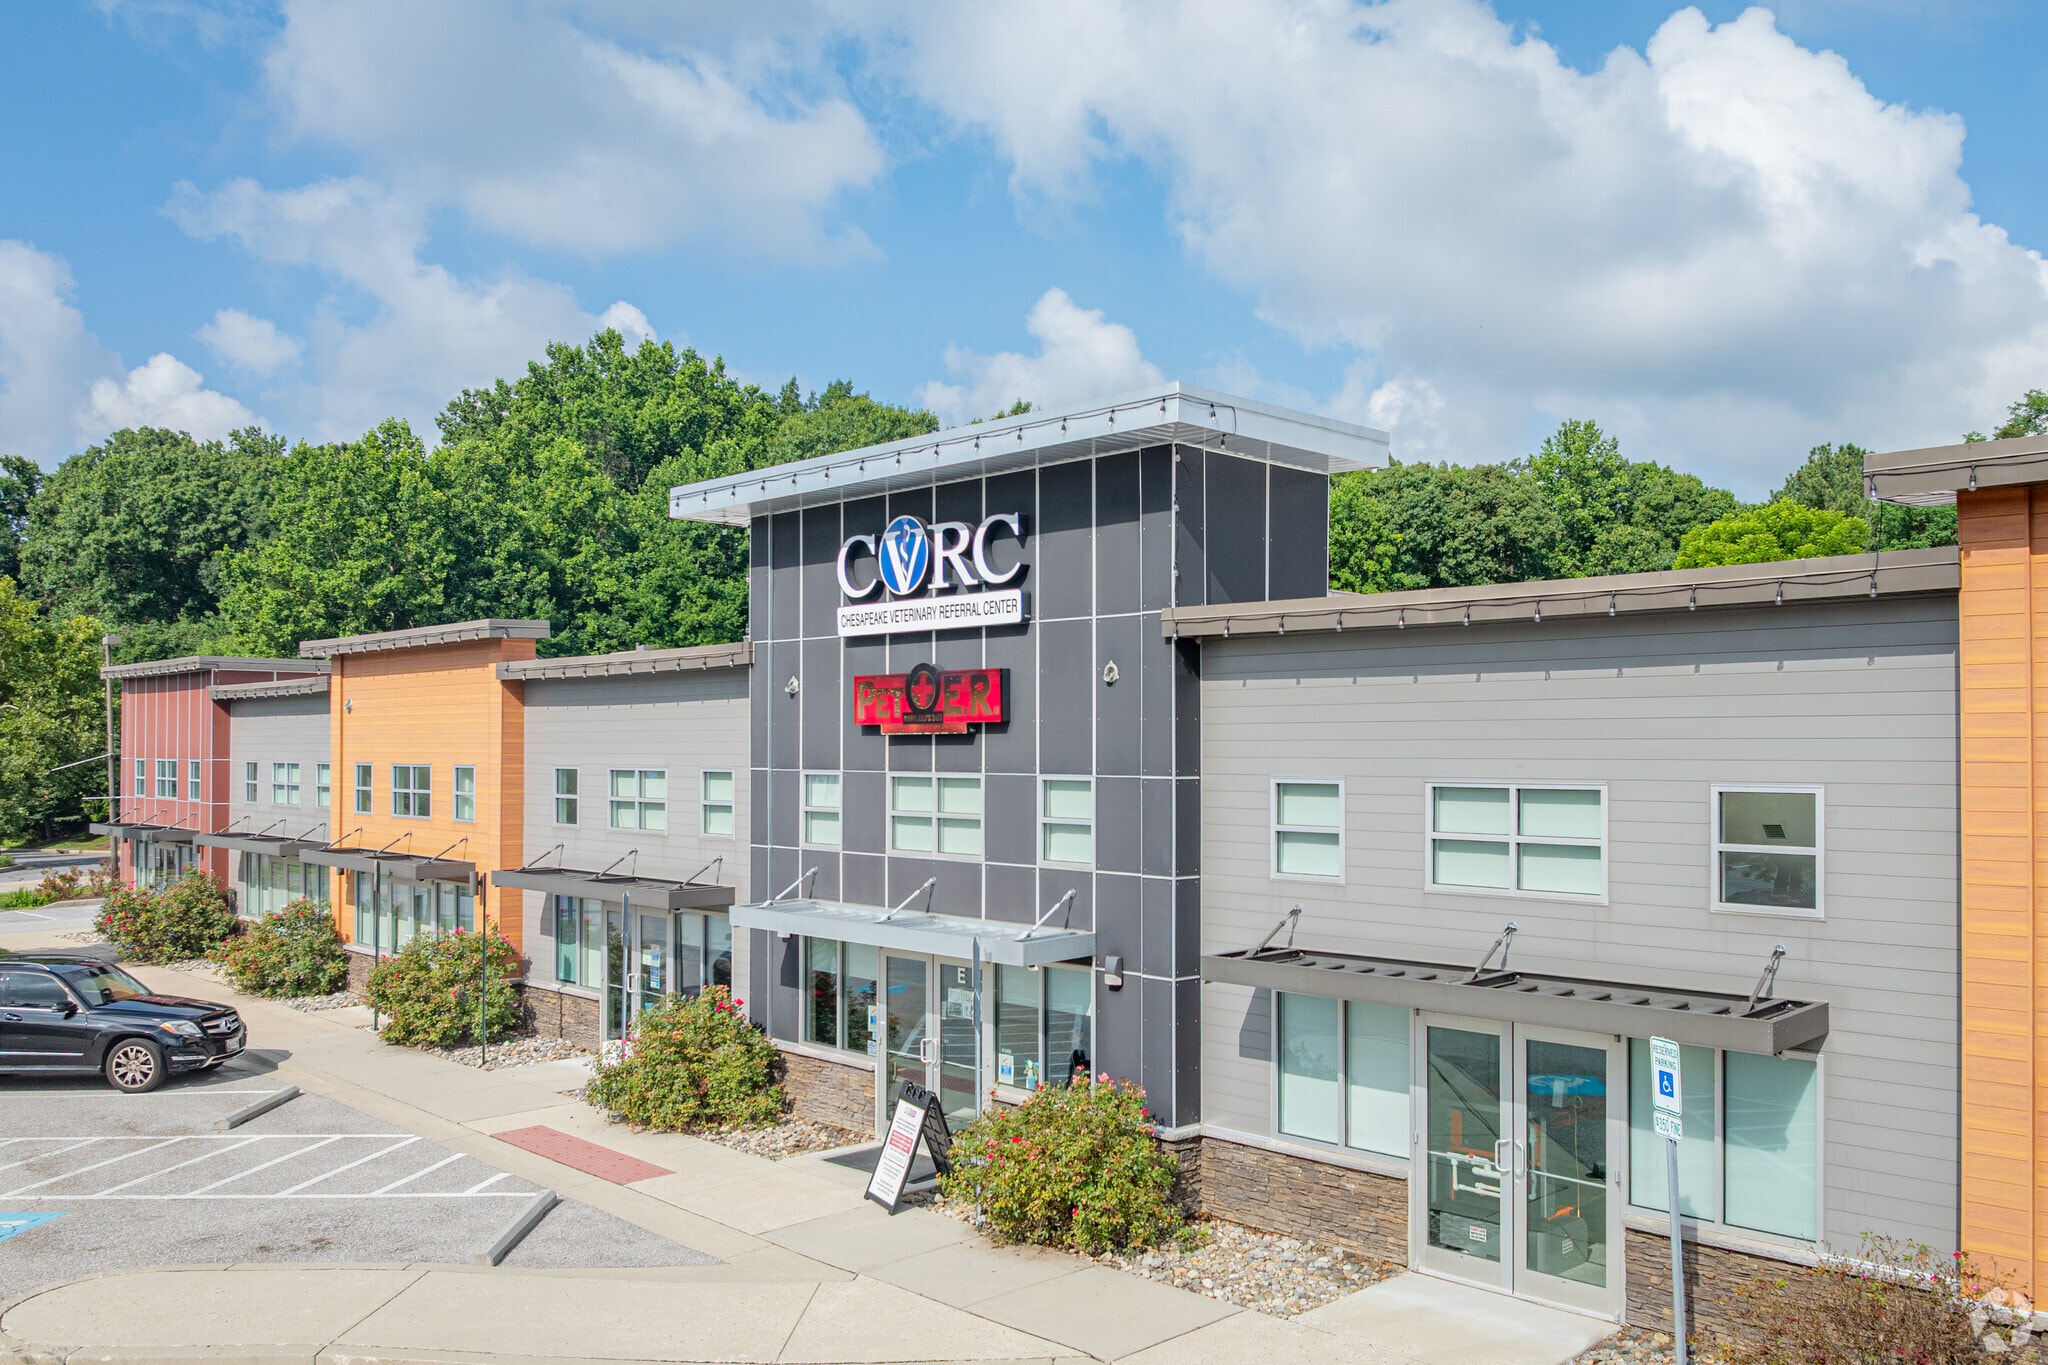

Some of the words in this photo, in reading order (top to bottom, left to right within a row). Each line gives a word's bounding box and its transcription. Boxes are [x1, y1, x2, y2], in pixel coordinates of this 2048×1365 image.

[837, 512, 1021, 598] CVRC
[841, 609, 889, 628] CHESAPEAKE
[890, 606, 938, 624] VETERINARY
[939, 602, 981, 619] REFERRAL
[983, 598, 1018, 615] CENTER
[957, 967, 966, 984] E
[1652, 1044, 1678, 1059] RESERVED
[1655, 1056, 1676, 1071] PARKING
[1671, 1121, 1681, 1137] FINE
